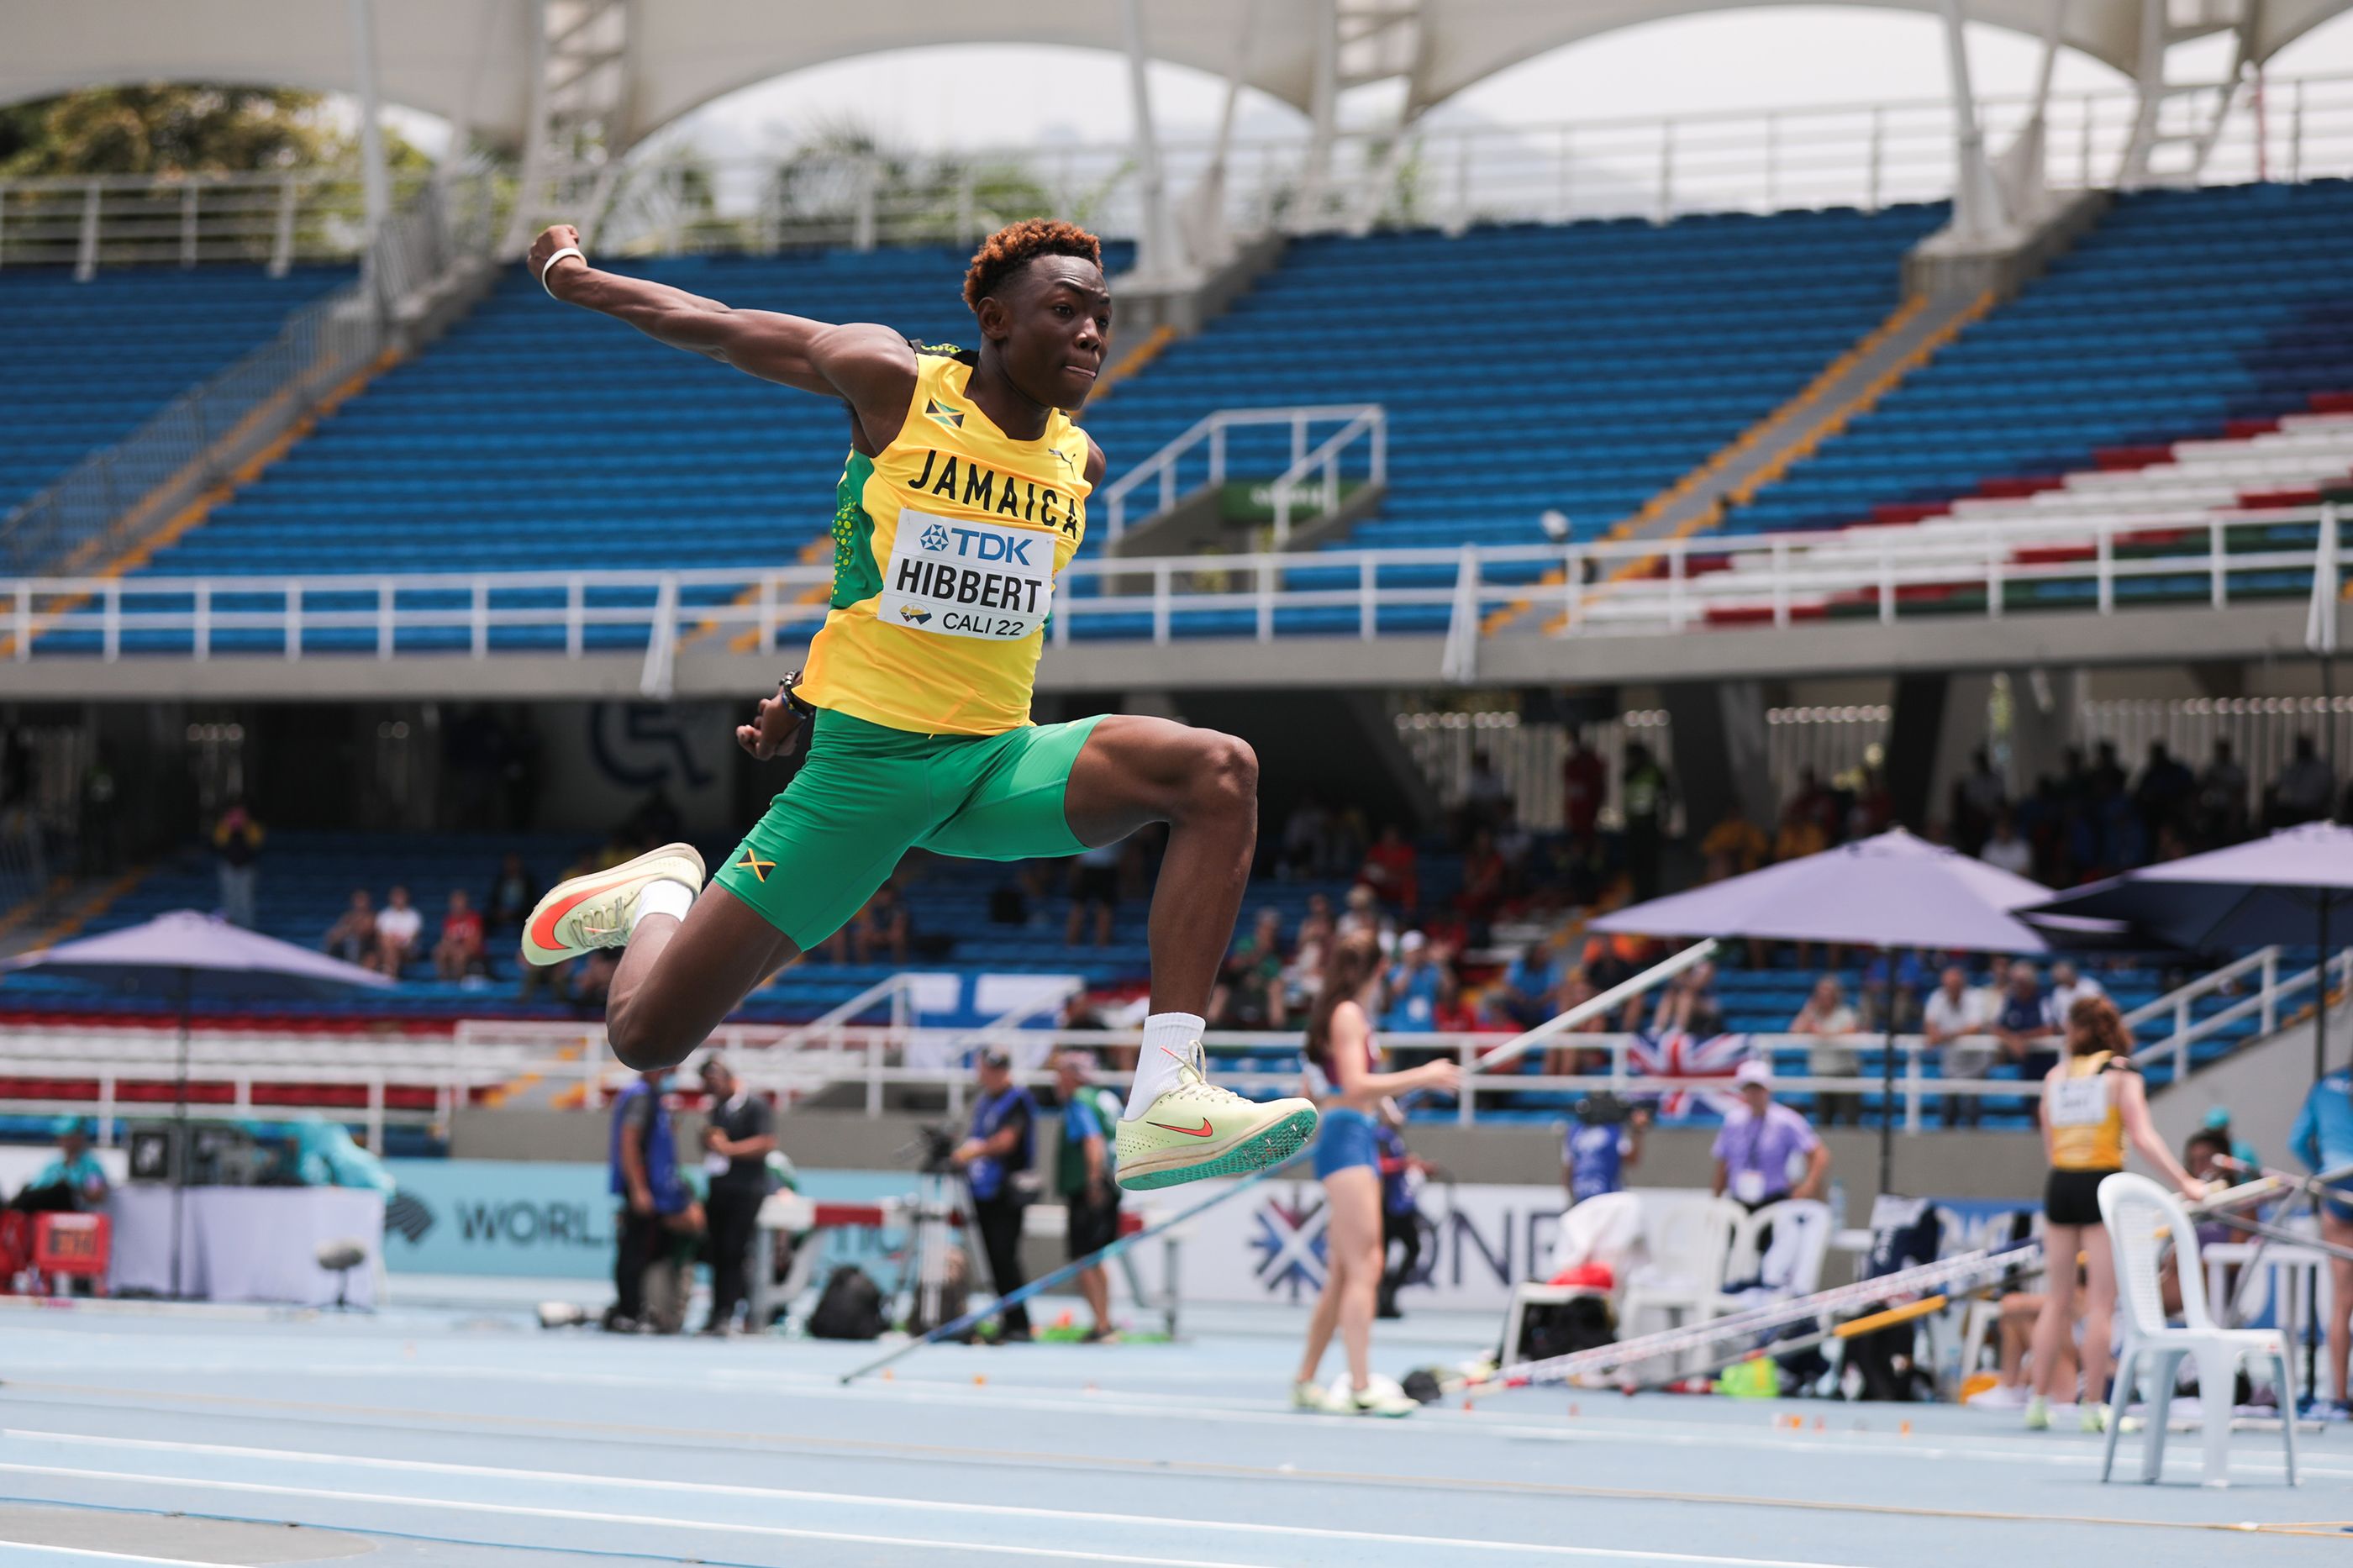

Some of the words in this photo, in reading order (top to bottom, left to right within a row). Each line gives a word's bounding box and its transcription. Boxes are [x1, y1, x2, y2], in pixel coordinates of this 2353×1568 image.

[908, 450, 1077, 539] JAMAICA
[950, 528, 1033, 566] TDK
[897, 558, 1042, 613] HIBBERT
[943, 613, 992, 634] CALI
[995, 620, 1024, 635] 22
[455, 1200, 605, 1249] WORL
